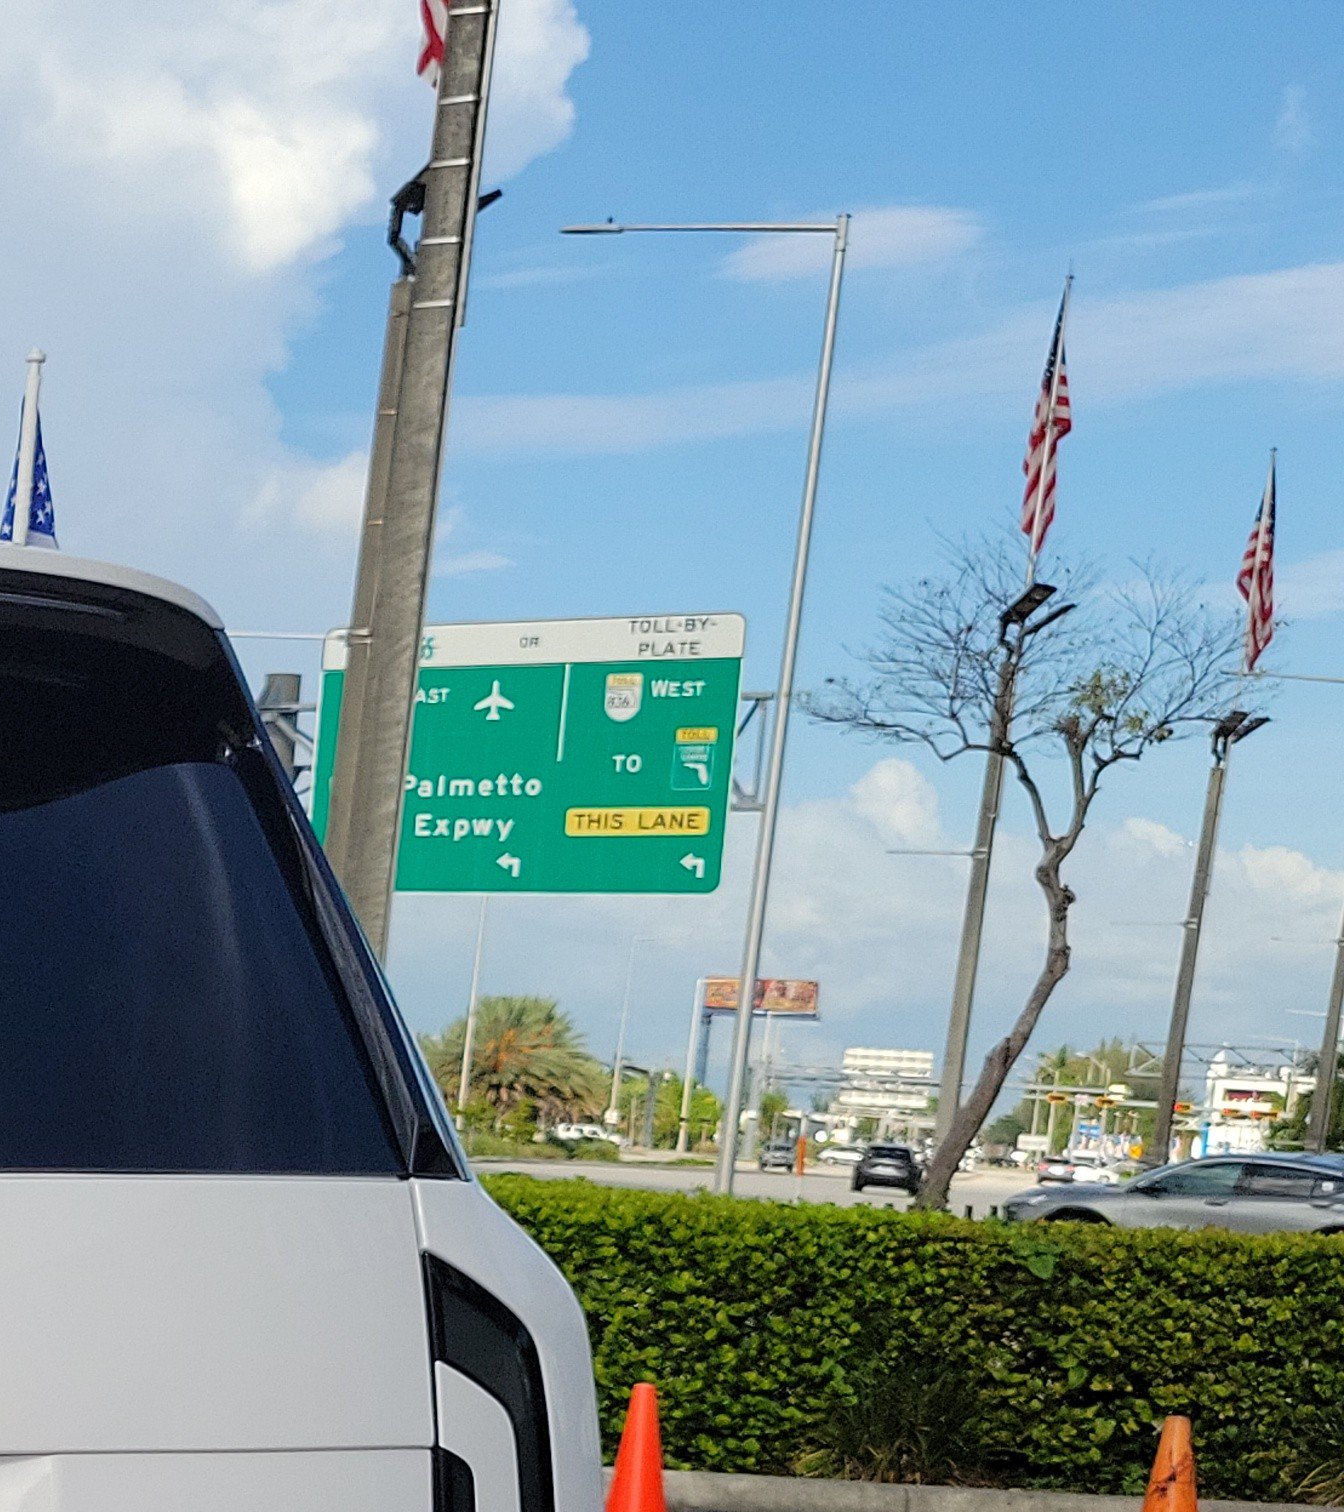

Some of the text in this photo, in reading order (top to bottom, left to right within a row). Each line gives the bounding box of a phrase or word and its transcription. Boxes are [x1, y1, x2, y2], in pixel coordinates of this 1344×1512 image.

[638, 641, 701, 657] PLATE
[413, 687, 451, 704] AST
[650, 678, 706, 698] WEST
[612, 754, 643, 774] TO
[402, 772, 543, 798] Palmetto
[414, 813, 516, 842] Expwy
[574, 812, 701, 831] THIS LANE
